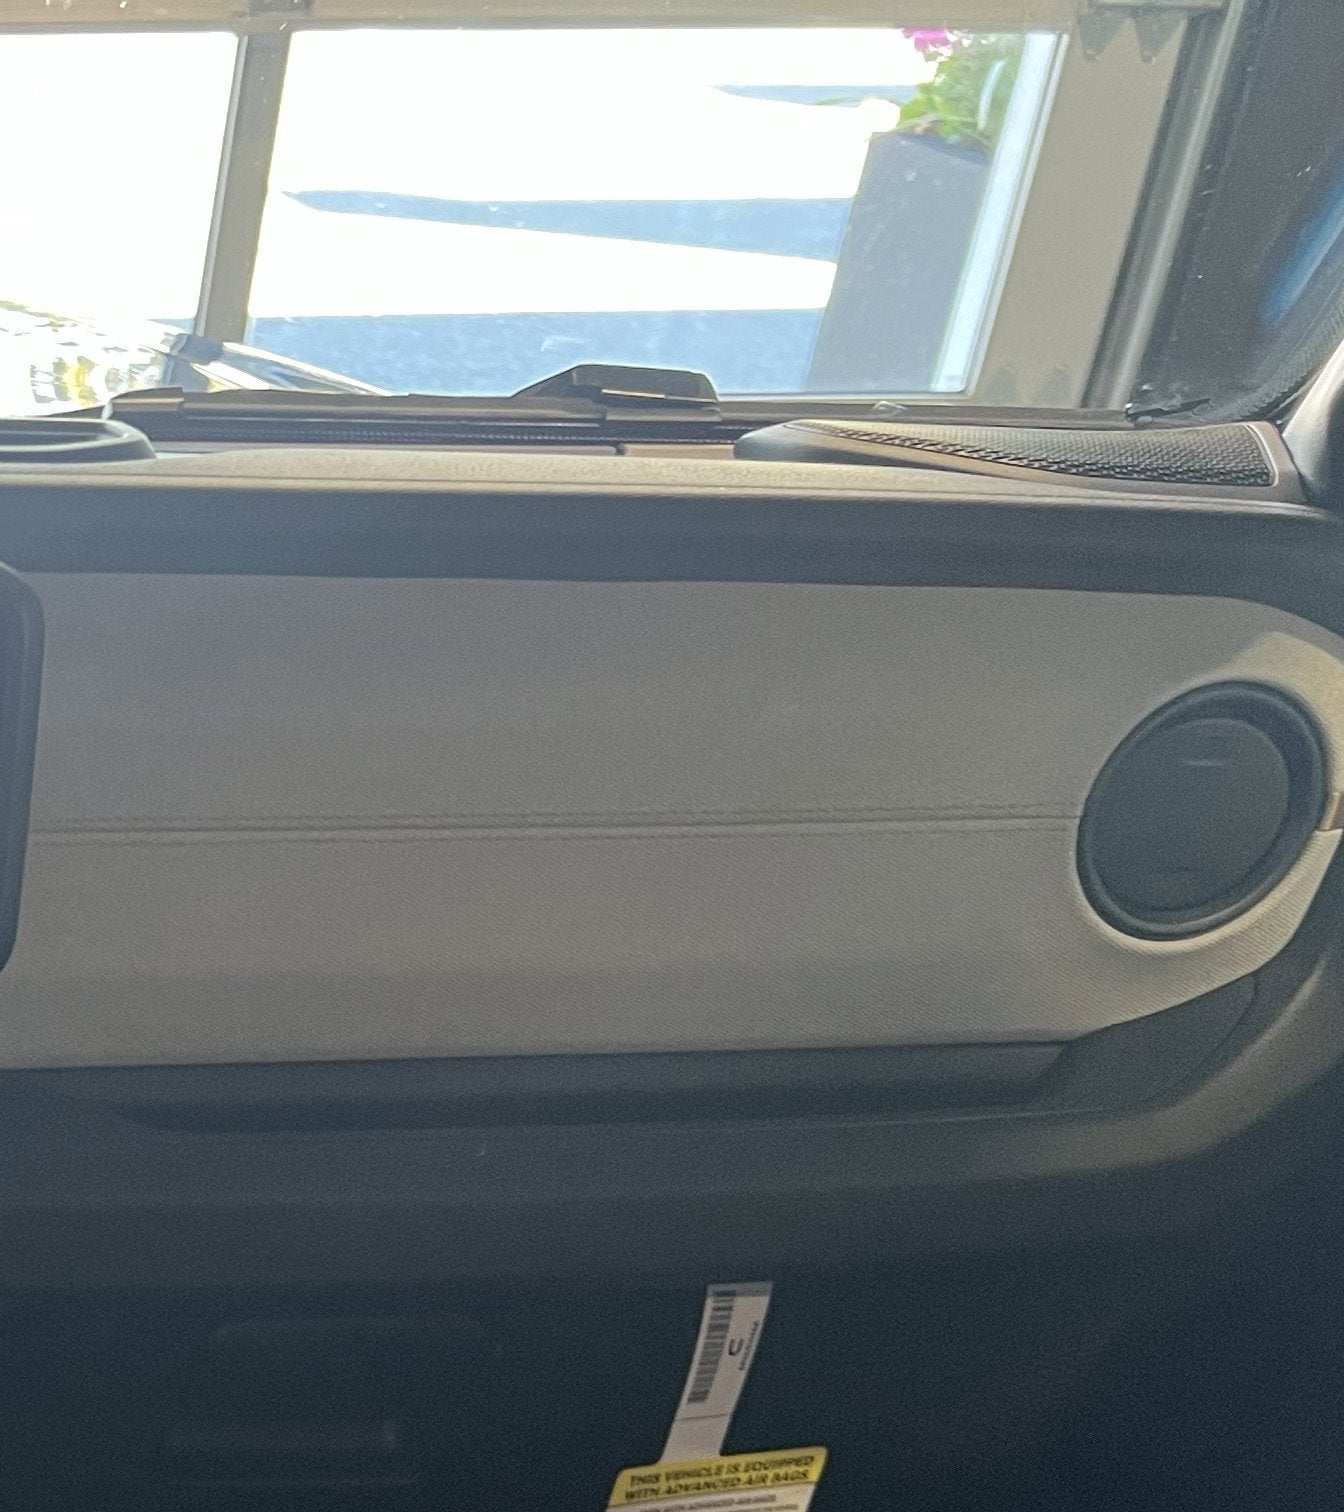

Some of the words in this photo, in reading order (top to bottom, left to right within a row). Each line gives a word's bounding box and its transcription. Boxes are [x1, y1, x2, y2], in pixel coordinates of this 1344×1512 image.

[624, 1487, 660, 1501] WITH
[663, 1477, 741, 1495] ADVANCED
[743, 1473, 769, 1486] AIR
[770, 1469, 809, 1484] BAGS
[629, 1474, 660, 1488] THIS
[665, 1465, 722, 1482] VEHICLE
[725, 1462, 741, 1474] IS
[744, 1455, 815, 1473] EQUIPPED
